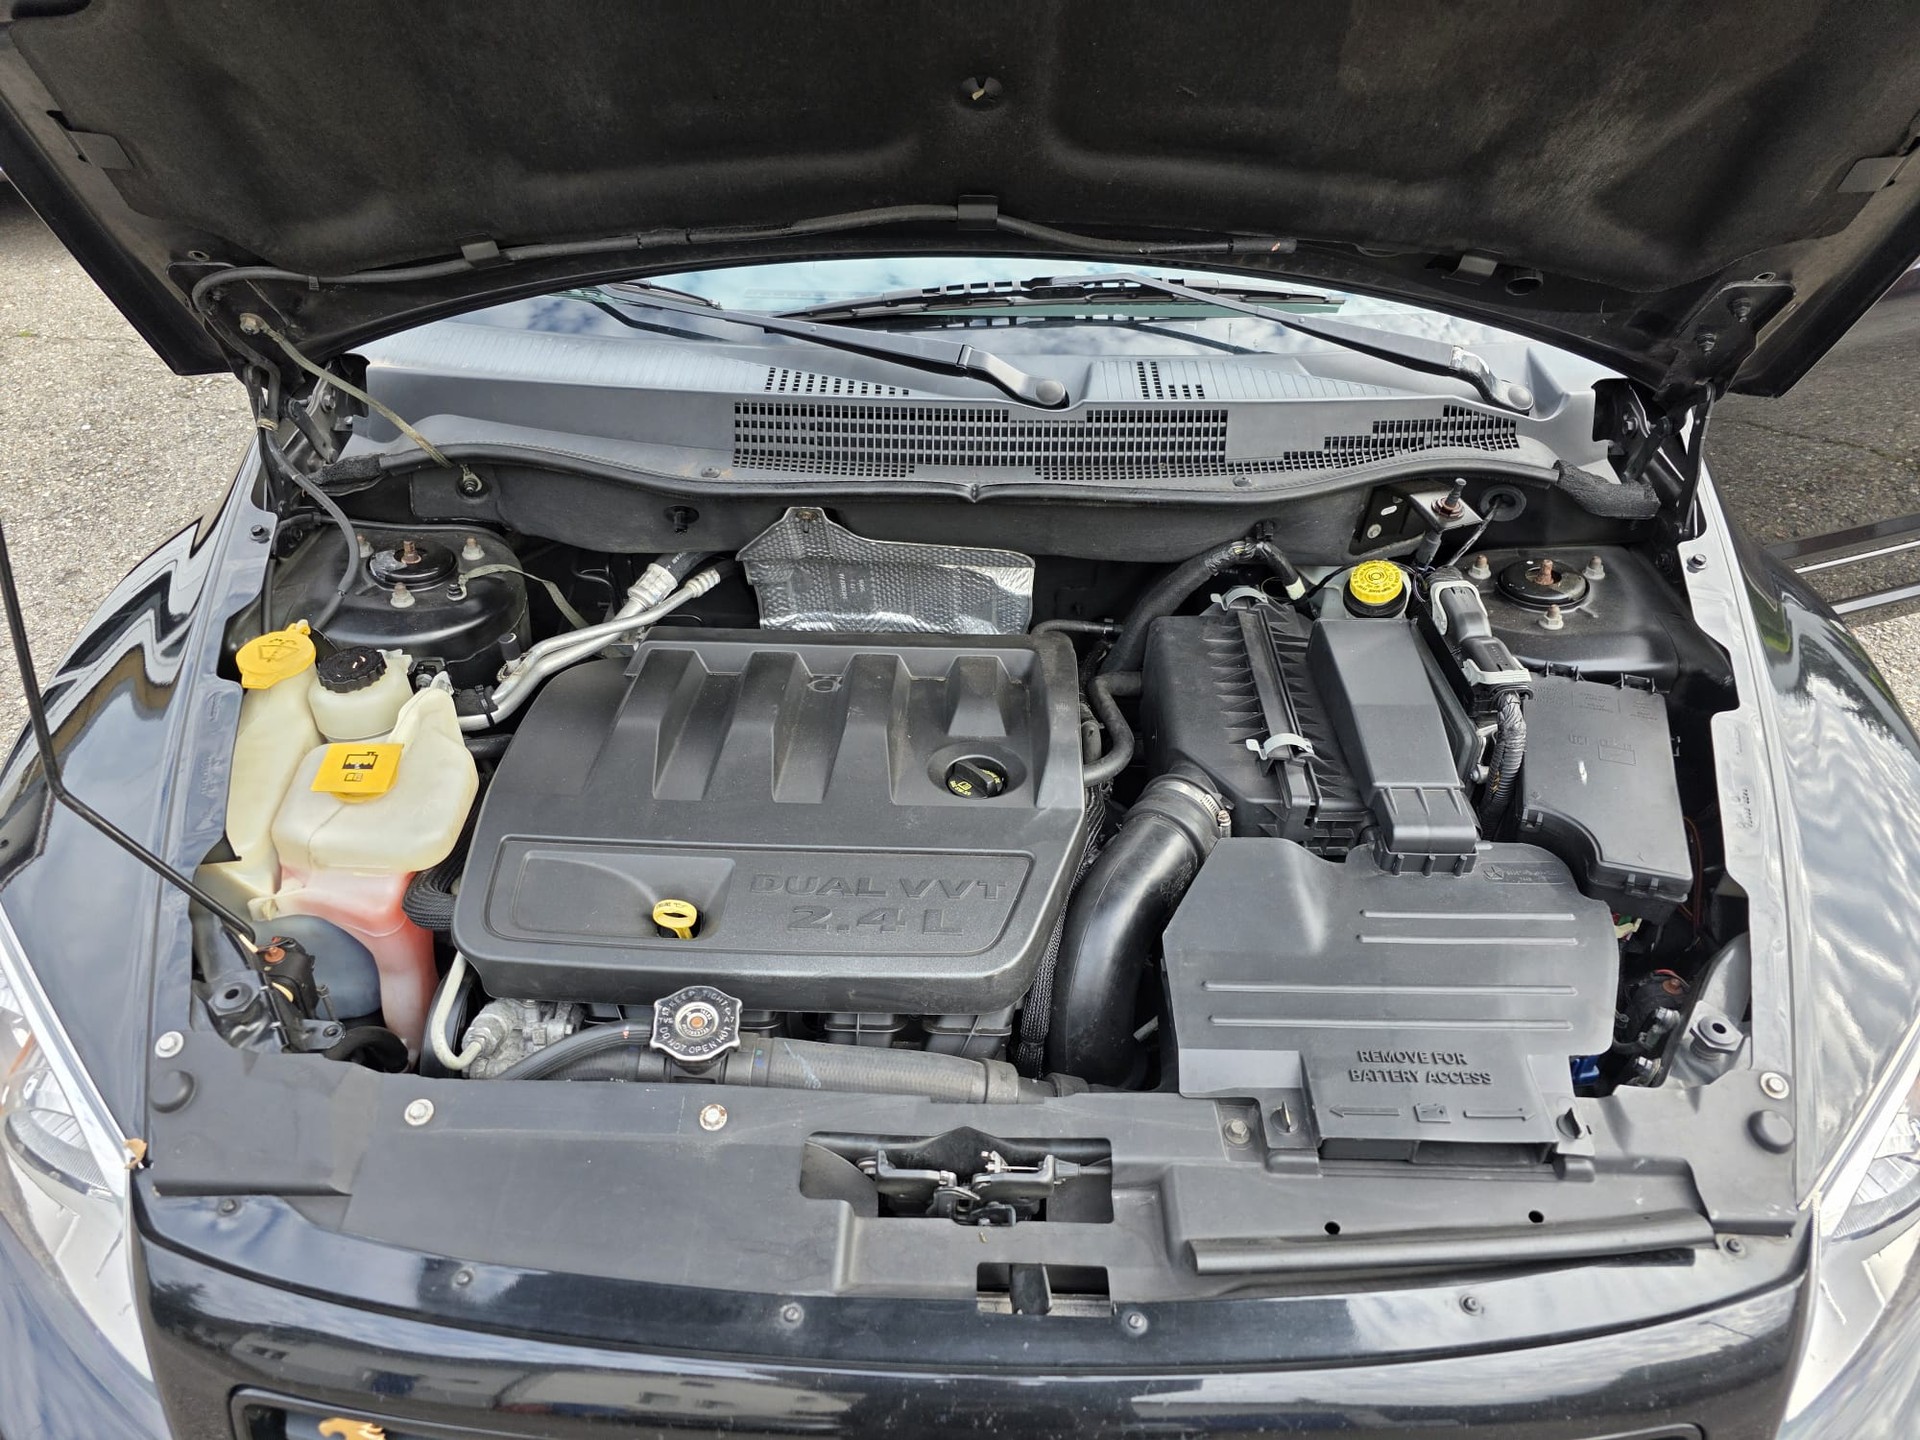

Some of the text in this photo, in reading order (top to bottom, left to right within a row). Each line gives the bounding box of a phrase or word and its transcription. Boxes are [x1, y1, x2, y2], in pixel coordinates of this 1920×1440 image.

[751, 873, 1007, 900] DUAL VVT
[669, 990, 728, 1008] KEEP TIGHT
[660, 1027, 670, 1039] DO
[668, 1039, 687, 1052] NOT
[688, 1042, 717, 1054] OPEN
[716, 1026, 732, 1043] HOT
[1357, 1049, 1468, 1065] REMOVE FOR
[1349, 1069, 1493, 1085] BATTERY ACCESS
